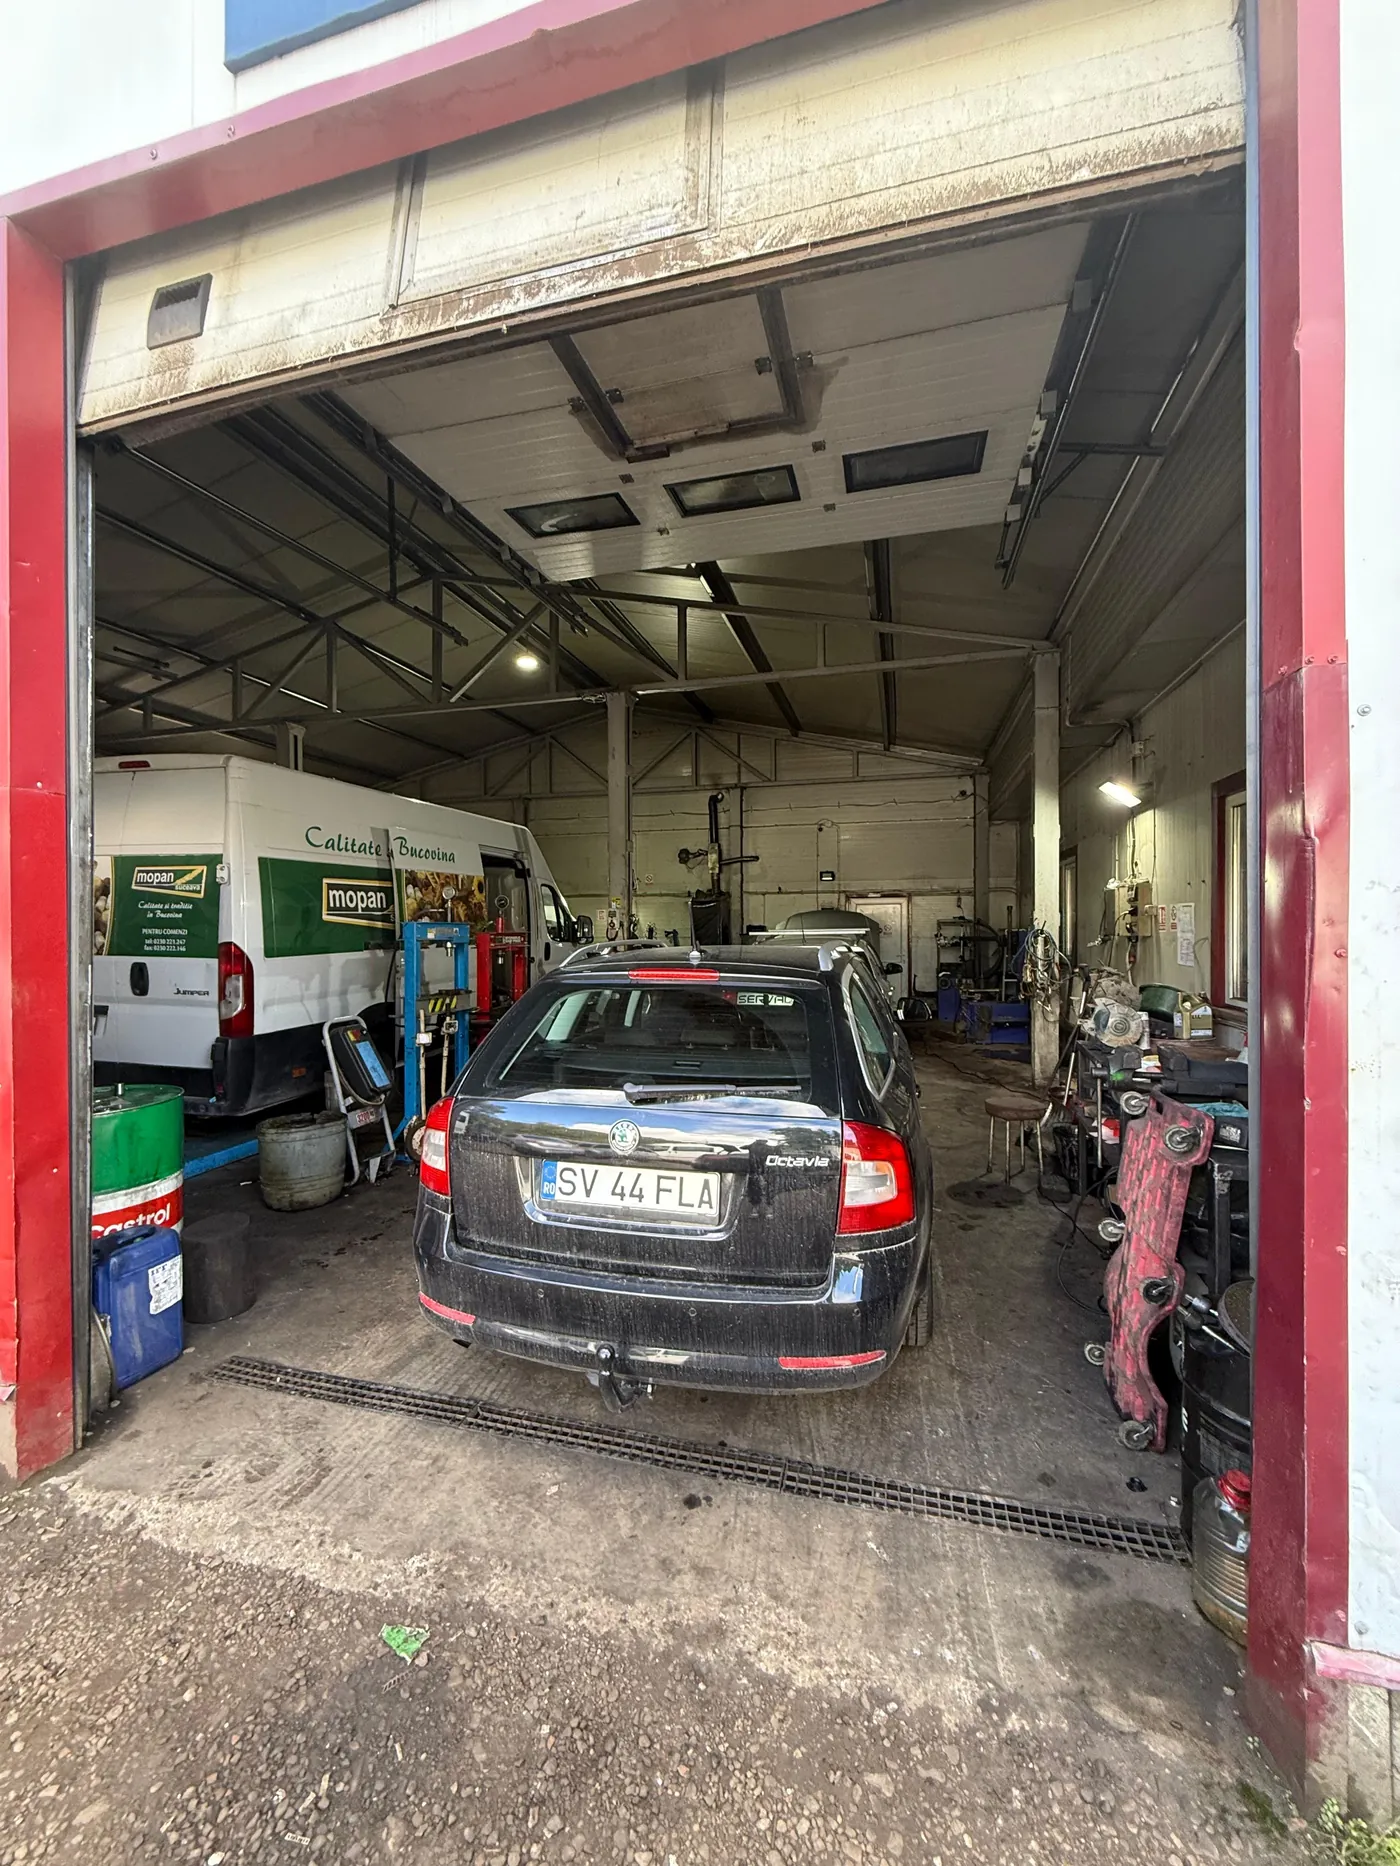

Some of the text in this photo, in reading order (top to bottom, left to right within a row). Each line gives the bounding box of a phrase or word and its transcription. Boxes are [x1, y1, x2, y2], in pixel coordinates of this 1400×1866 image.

[305, 825, 456, 864] Calitate Bucovina
[136, 872, 174, 885] mopan
[328, 887, 386, 913] mopan
[765, 1154, 829, 1168] Octavia
[543, 1182, 555, 1194] RO
[558, 1166, 713, 1210] SV 44 FLA
